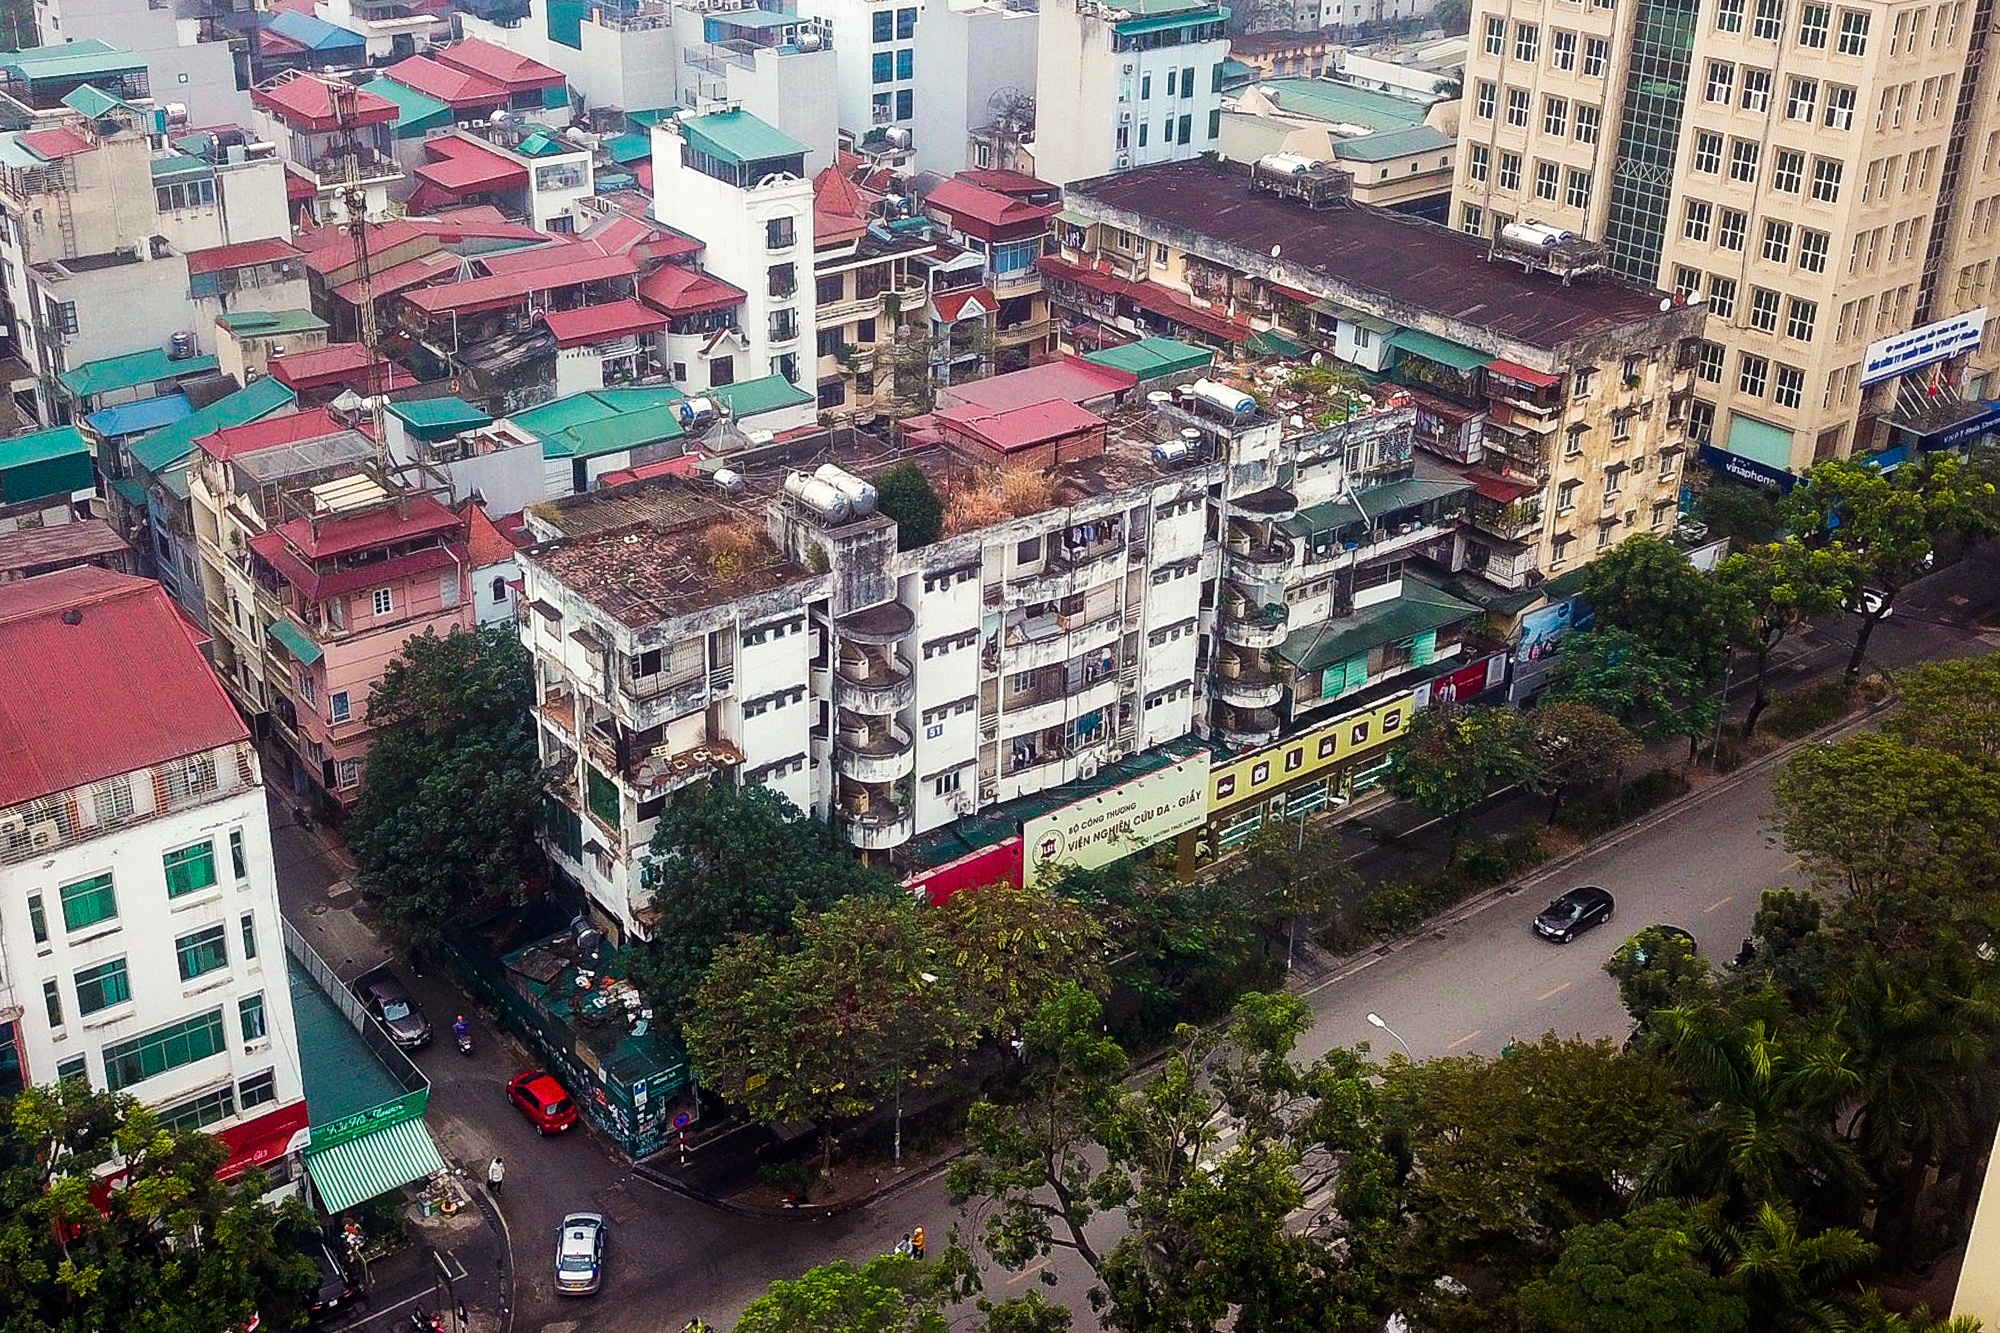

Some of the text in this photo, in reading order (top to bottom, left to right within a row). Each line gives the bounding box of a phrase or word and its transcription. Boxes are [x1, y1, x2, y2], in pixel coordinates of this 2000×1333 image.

[1068, 835, 1091, 852] VIỆN
[1093, 819, 1131, 843] NGHIÊN
[1133, 809, 1155, 826] CỨU
[1156, 804, 1170, 816] DA
[1081, 814, 1105, 830] CÔNG
[1106, 802, 1137, 820] THƯƠNG
